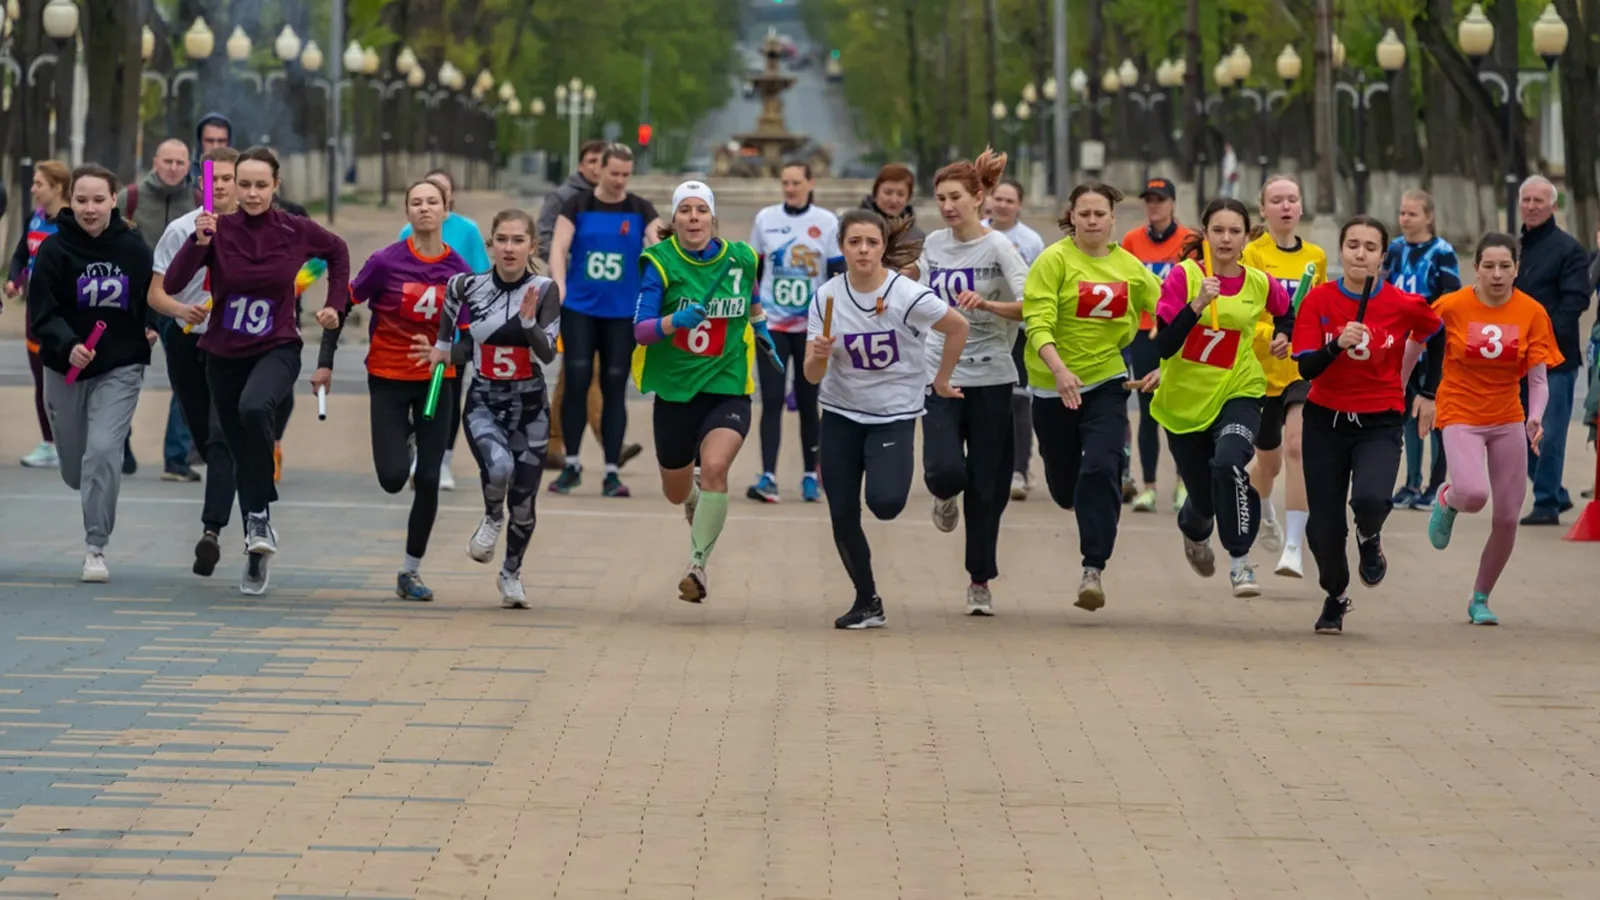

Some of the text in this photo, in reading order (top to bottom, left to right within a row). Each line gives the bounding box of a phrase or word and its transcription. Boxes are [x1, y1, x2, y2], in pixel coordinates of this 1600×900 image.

[588, 253, 622, 280] 65
[728, 267, 743, 294] 7
[82, 276, 123, 308] 12
[413, 286, 438, 320] 4
[775, 279, 808, 306] 60
[1090, 285, 1114, 318] 2
[230, 297, 270, 334] 19
[687, 320, 712, 354] 6
[849, 332, 894, 368] 15
[1200, 328, 1226, 362] 7
[1347, 331, 1371, 361] 8
[1480, 324, 1503, 359] 3
[492, 347, 517, 378] 5
